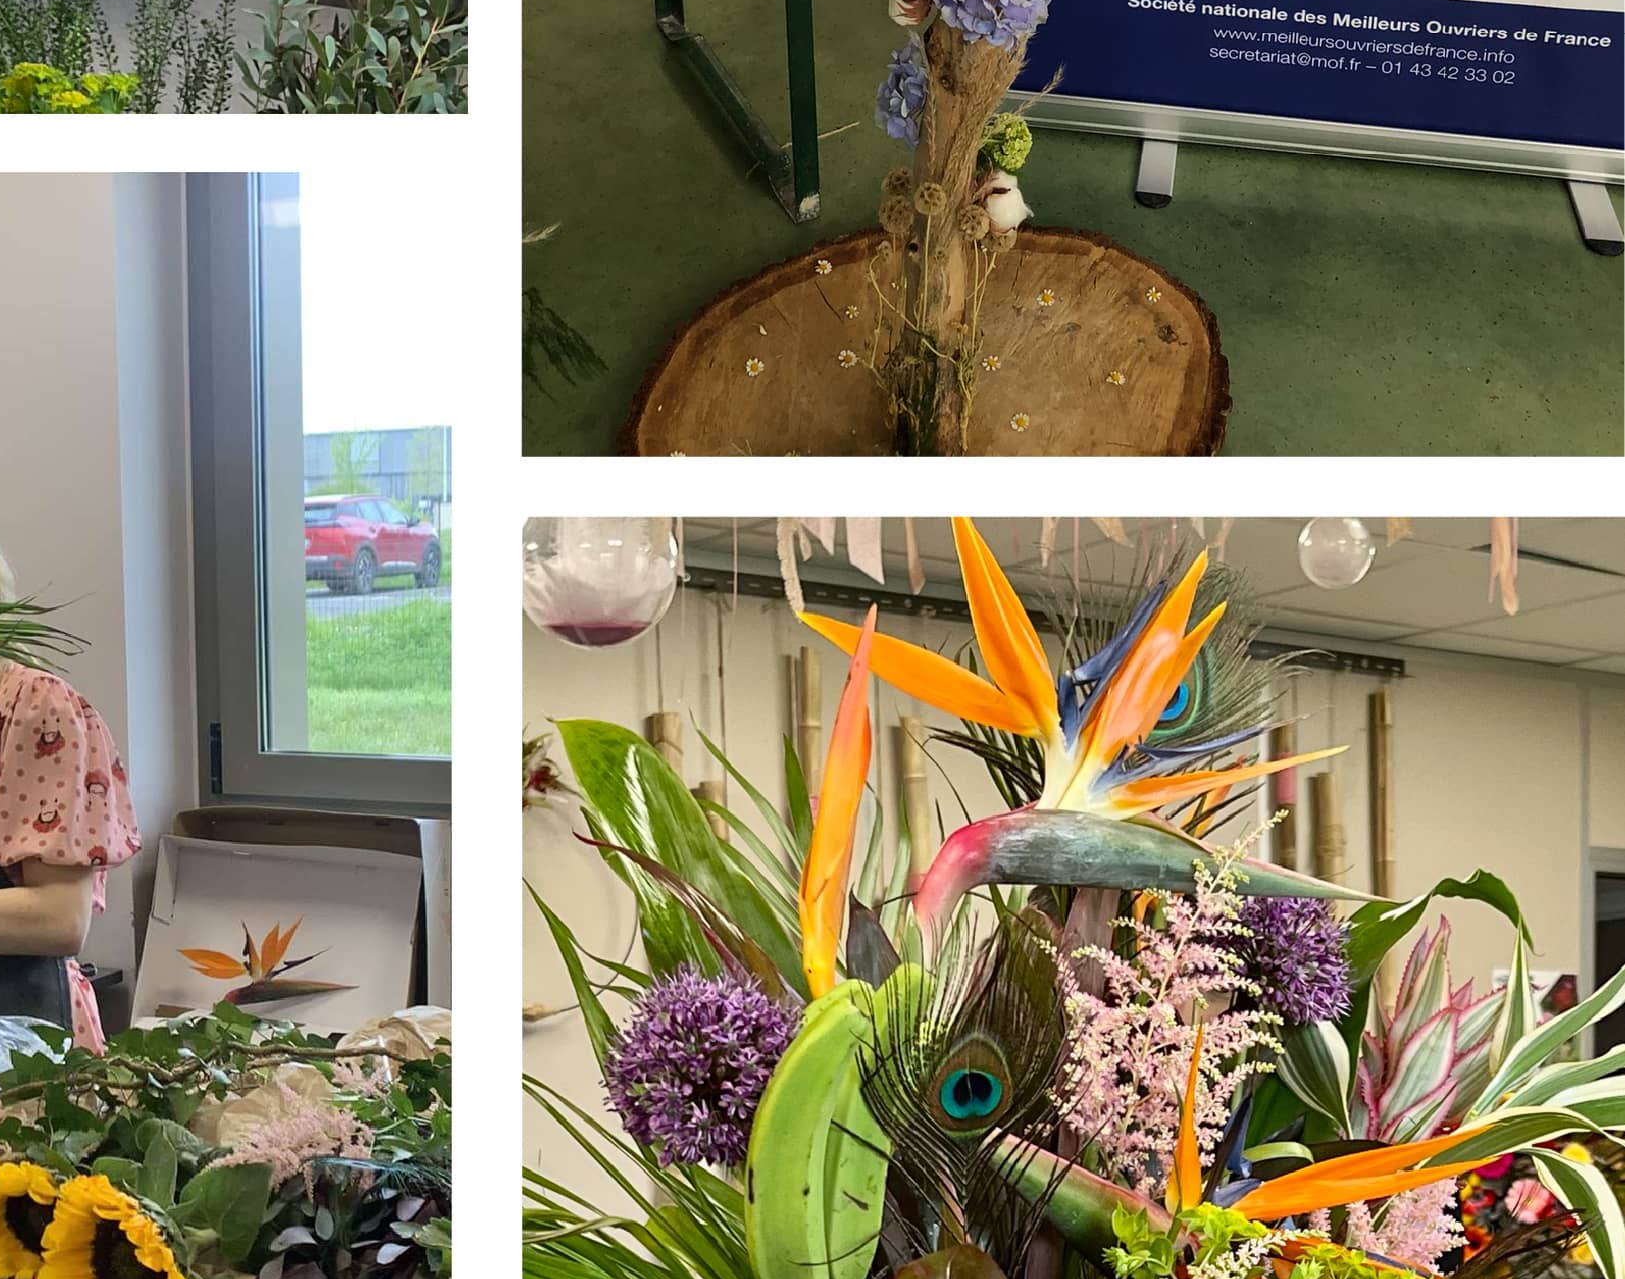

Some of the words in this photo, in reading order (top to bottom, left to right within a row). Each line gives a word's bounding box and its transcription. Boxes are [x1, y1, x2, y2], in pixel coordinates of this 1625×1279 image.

[1201, 3, 1289, 21] nationale
[1293, 10, 1327, 25] des
[1333, 13, 1420, 33] Meilleurs
[1426, 20, 1508, 39] Ouvriers
[1513, 28, 1538, 41] de
[1544, 30, 1612, 47] France
[1213, 28, 1515, 64] www.meilleursouvriersdefrance.info
[1209, 47, 1362, 71] secretariat@mof.fr
[1381, 60, 1402, 74] 01
[1409, 63, 1432, 77] 43
[1437, 66, 1459, 80] 42
[1464, 69, 1487, 83] 33
[1492, 71, 1516, 85] 02
